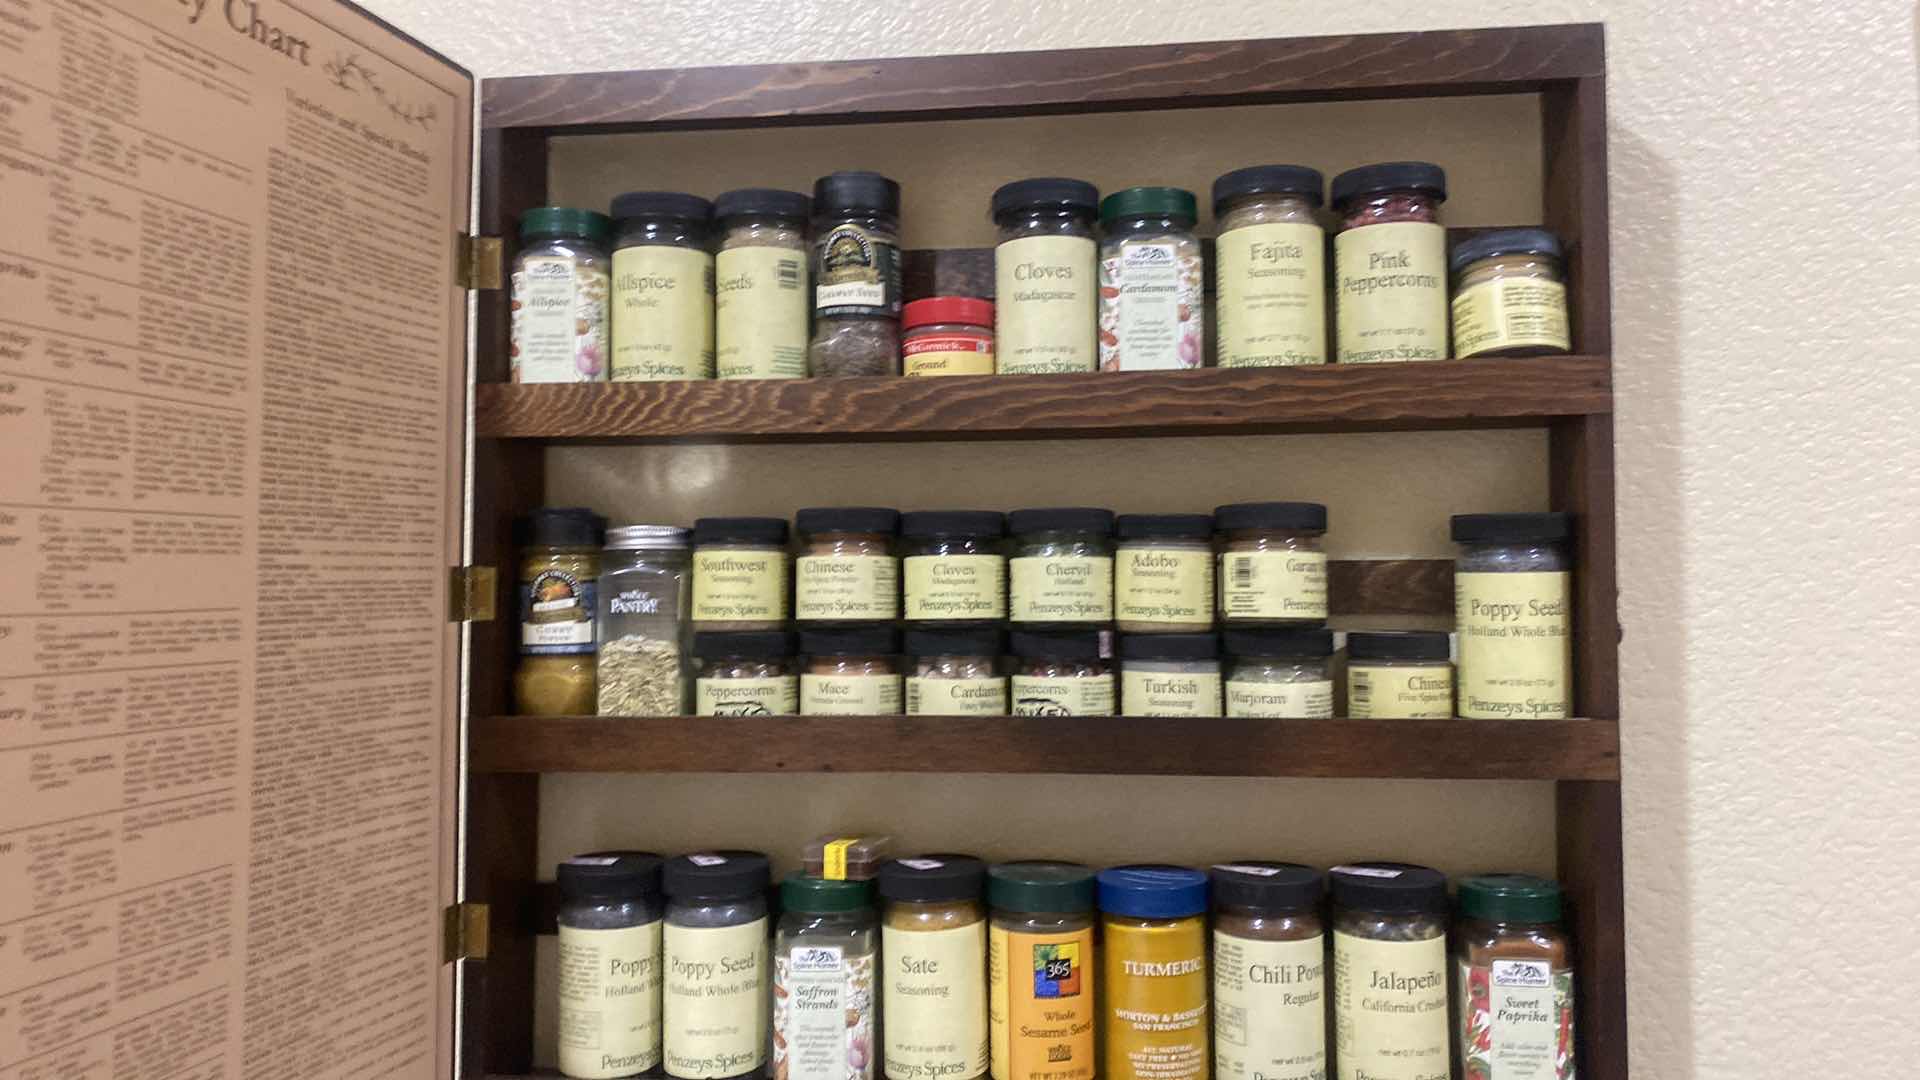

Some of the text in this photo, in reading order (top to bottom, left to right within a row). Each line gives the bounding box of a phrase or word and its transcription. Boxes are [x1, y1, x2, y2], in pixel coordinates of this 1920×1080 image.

[224, 0, 311, 66] Chart
[1250, 242, 1304, 264] Fajita
[1368, 251, 1411, 270] Pink
[1014, 263, 1073, 281] Cloves
[1247, 268, 1306, 281] Seasoning
[1342, 273, 1439, 295] Peppercorns
[700, 557, 768, 573] Southwest
[804, 560, 856, 574] Chinese
[1130, 553, 1180, 568] Adobo
[932, 563, 976, 576] Cloves
[610, 598, 658, 614] PANTRY
[918, 599, 994, 614] Penzeys Spices
[1072, 601, 1104, 616] Spices
[1471, 599, 1524, 622] Poppy
[705, 684, 776, 700] Peppercorns
[817, 681, 850, 696] Mace
[1143, 679, 1199, 695] Turkish
[1230, 691, 1288, 707] Marjoram
[1468, 696, 1524, 717] Penzeys
[671, 952, 755, 981] Poppy Seed
[900, 956, 939, 975] Sate
[1047, 962, 1070, 978] 365
[1122, 956, 1202, 977] TURMERIC
[1249, 963, 1291, 985] Chili
[604, 982, 645, 1000] Holland
[895, 982, 951, 998] Seasoning
[1369, 970, 1442, 997] Jalapeño
[795, 985, 838, 1000] Saffron
[1283, 991, 1321, 1007] Regular
[795, 999, 839, 1011] Strands
[1362, 998, 1415, 1014] California
[1505, 995, 1540, 1010] Sweet
[1043, 1011, 1077, 1023] Whole
[1497, 1009, 1549, 1024] Paprika
[1020, 1026, 1068, 1038] Sesame
[714, 1050, 755, 1072] Spices
[923, 1060, 967, 1080] Spices
